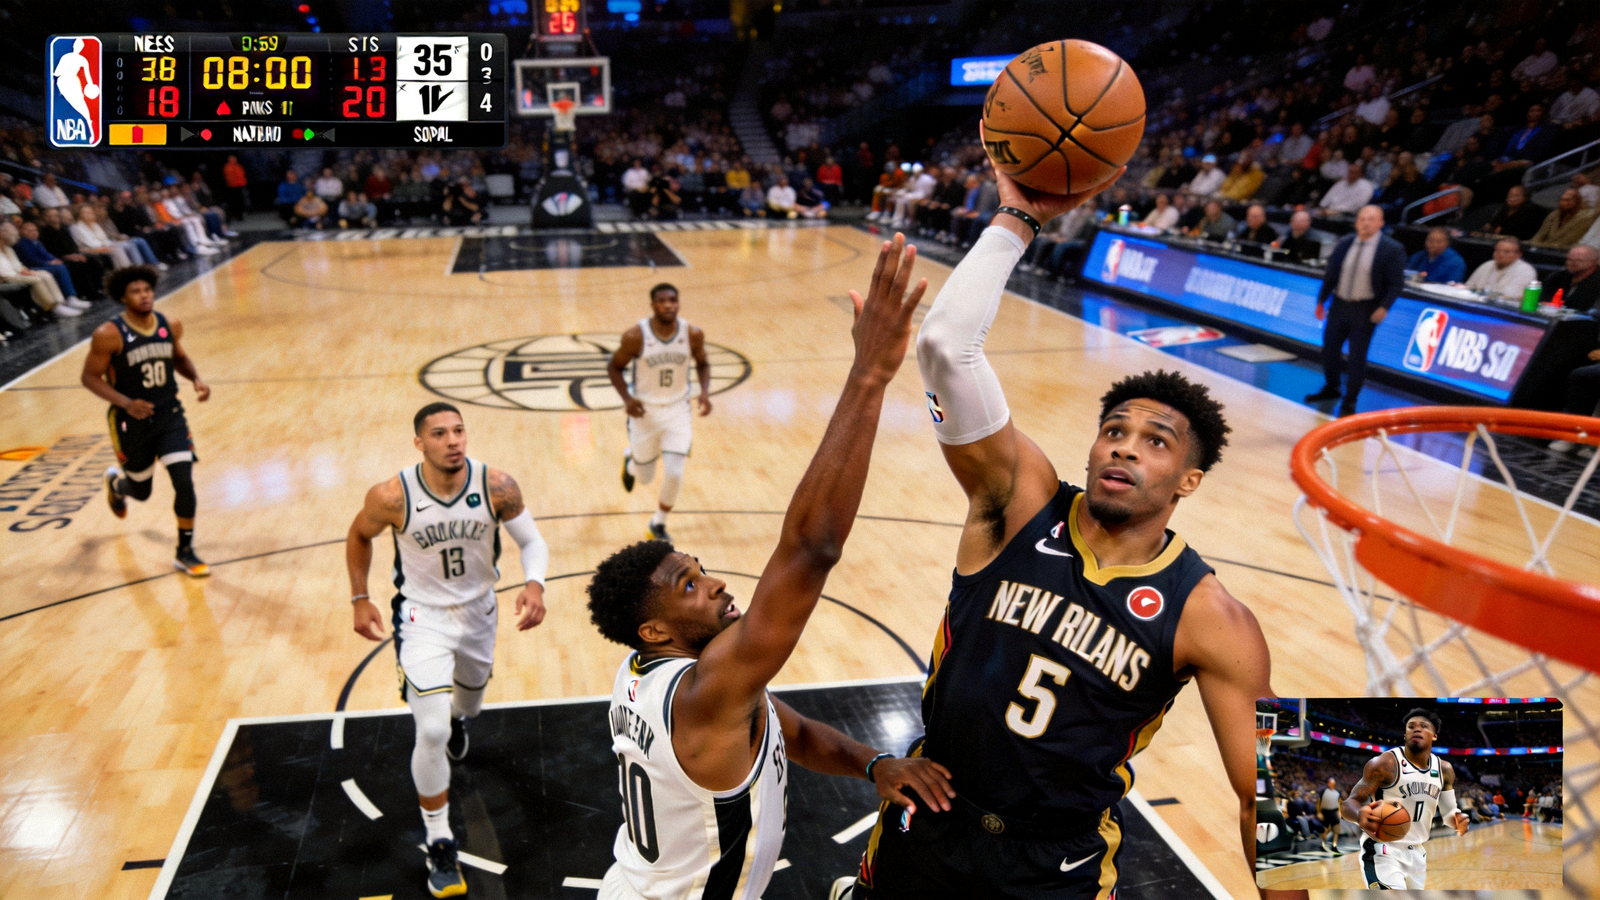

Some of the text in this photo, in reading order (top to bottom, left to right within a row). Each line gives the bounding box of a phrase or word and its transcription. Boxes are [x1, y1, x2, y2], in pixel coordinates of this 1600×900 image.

[141, 360, 167, 389] 30
[440, 547, 465, 580] 13
[984, 580, 1065, 635] NEW
[1005, 653, 1072, 739] 5
